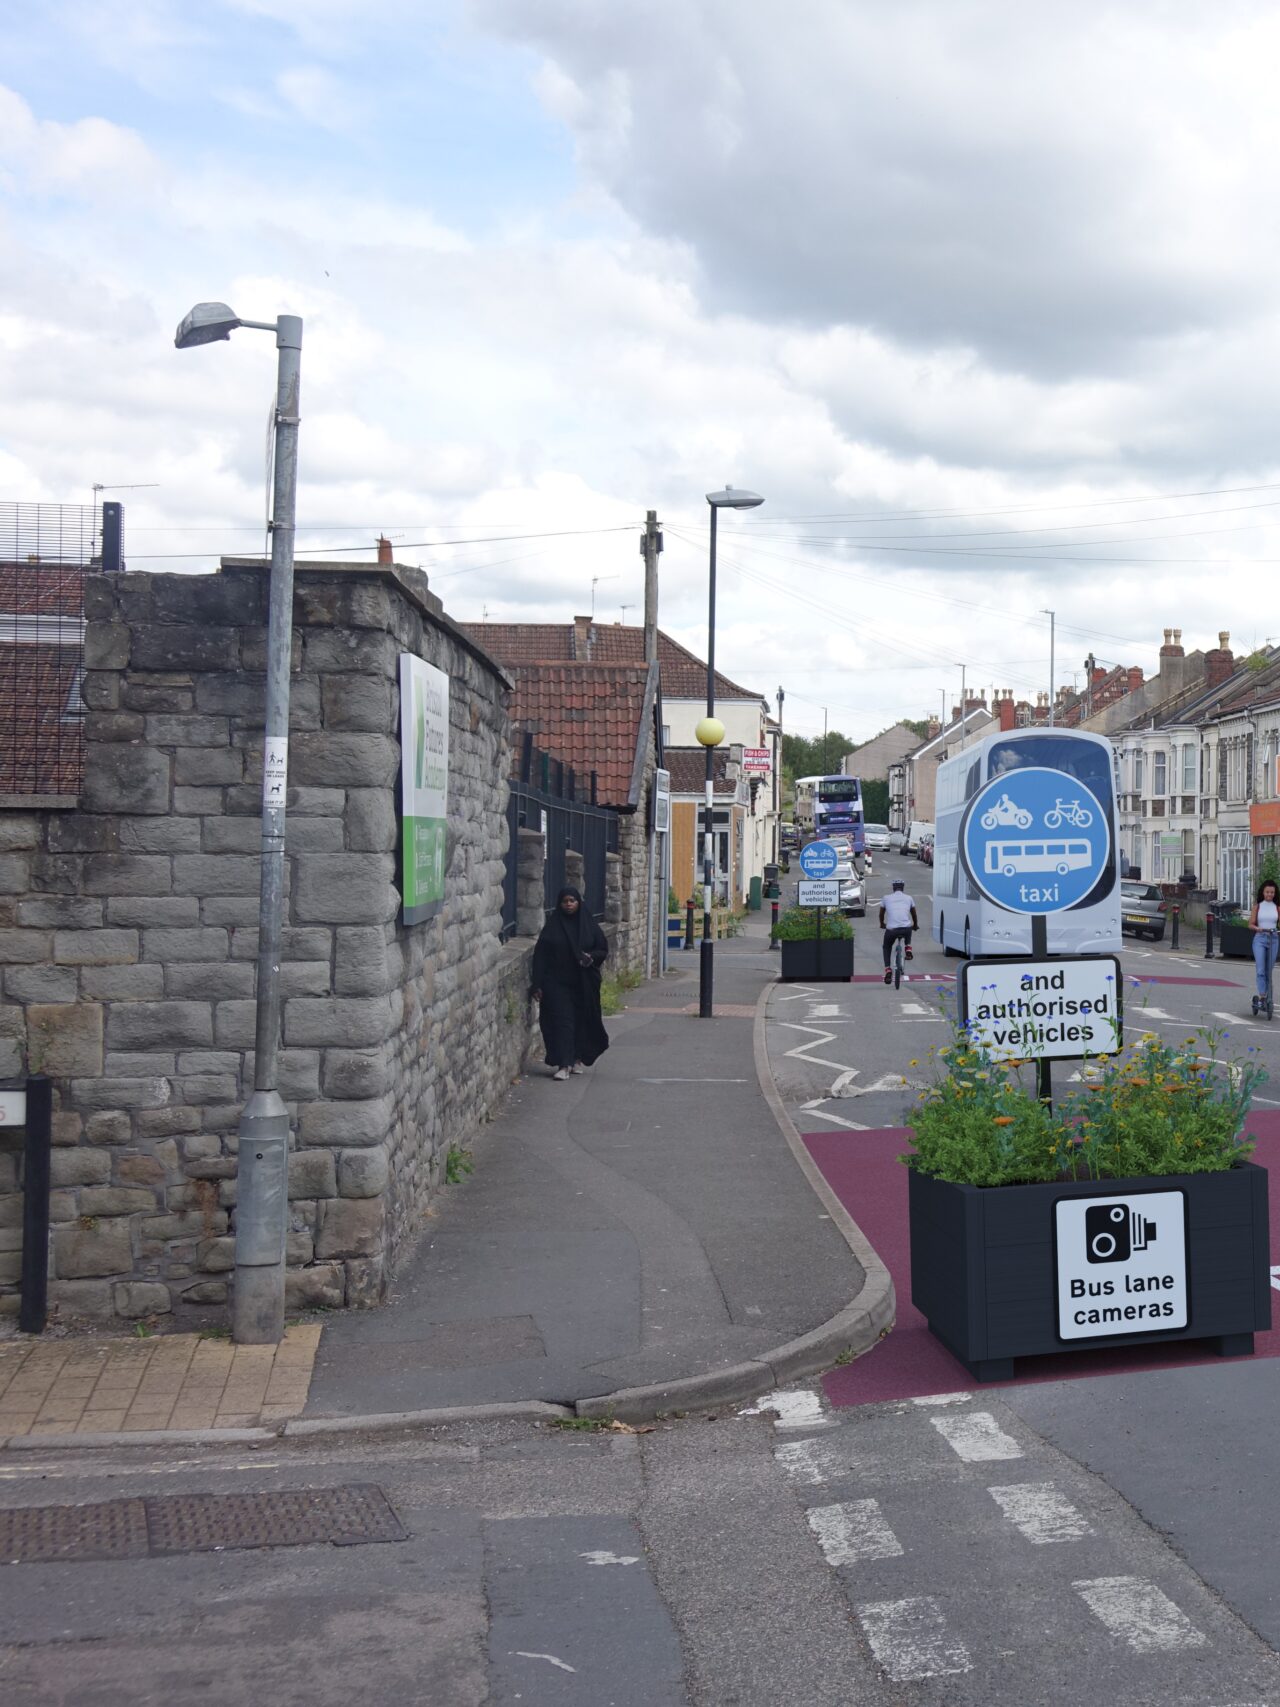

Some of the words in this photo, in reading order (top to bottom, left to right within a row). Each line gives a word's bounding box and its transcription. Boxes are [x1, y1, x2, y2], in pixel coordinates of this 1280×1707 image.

[1019, 884, 1059, 903] taxi
[1020, 970, 1065, 991] and
[977, 994, 1108, 1020] authorised
[993, 1022, 1095, 1046] vehicles
[1070, 1278, 1115, 1299] Bus
[1125, 1275, 1175, 1293] lane
[1073, 1302, 1174, 1325] cameras
